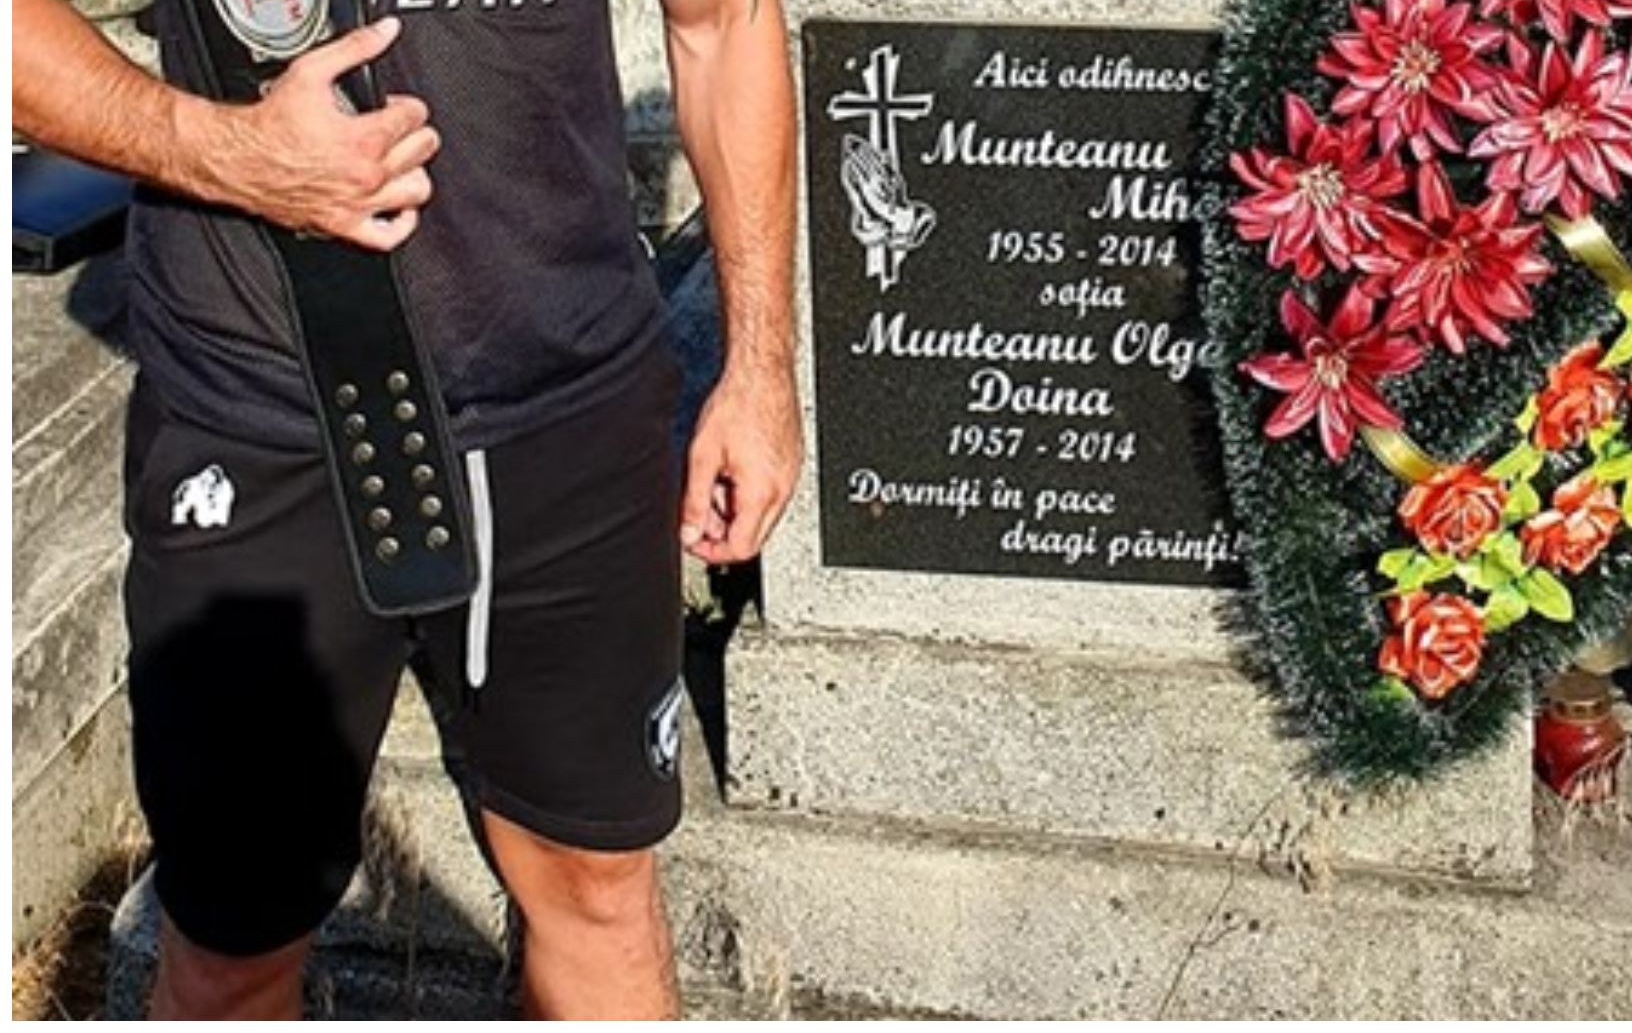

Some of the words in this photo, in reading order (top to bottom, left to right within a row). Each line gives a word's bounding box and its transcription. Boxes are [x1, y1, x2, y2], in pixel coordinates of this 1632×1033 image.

[974, 50, 1048, 90] Aici
[1059, 57, 1212, 92] odihnesc
[922, 120, 1172, 169] Munteanu
[987, 231, 1064, 263] 1955
[1098, 234, 1177, 266] 2014
[851, 312, 1097, 364] Munteanu
[968, 369, 1114, 417] Doina
[948, 425, 1025, 457] 1957
[1058, 430, 1137, 462] 2014
[1036, 488, 1116, 522] pace
[1001, 521, 1098, 563] dragi
